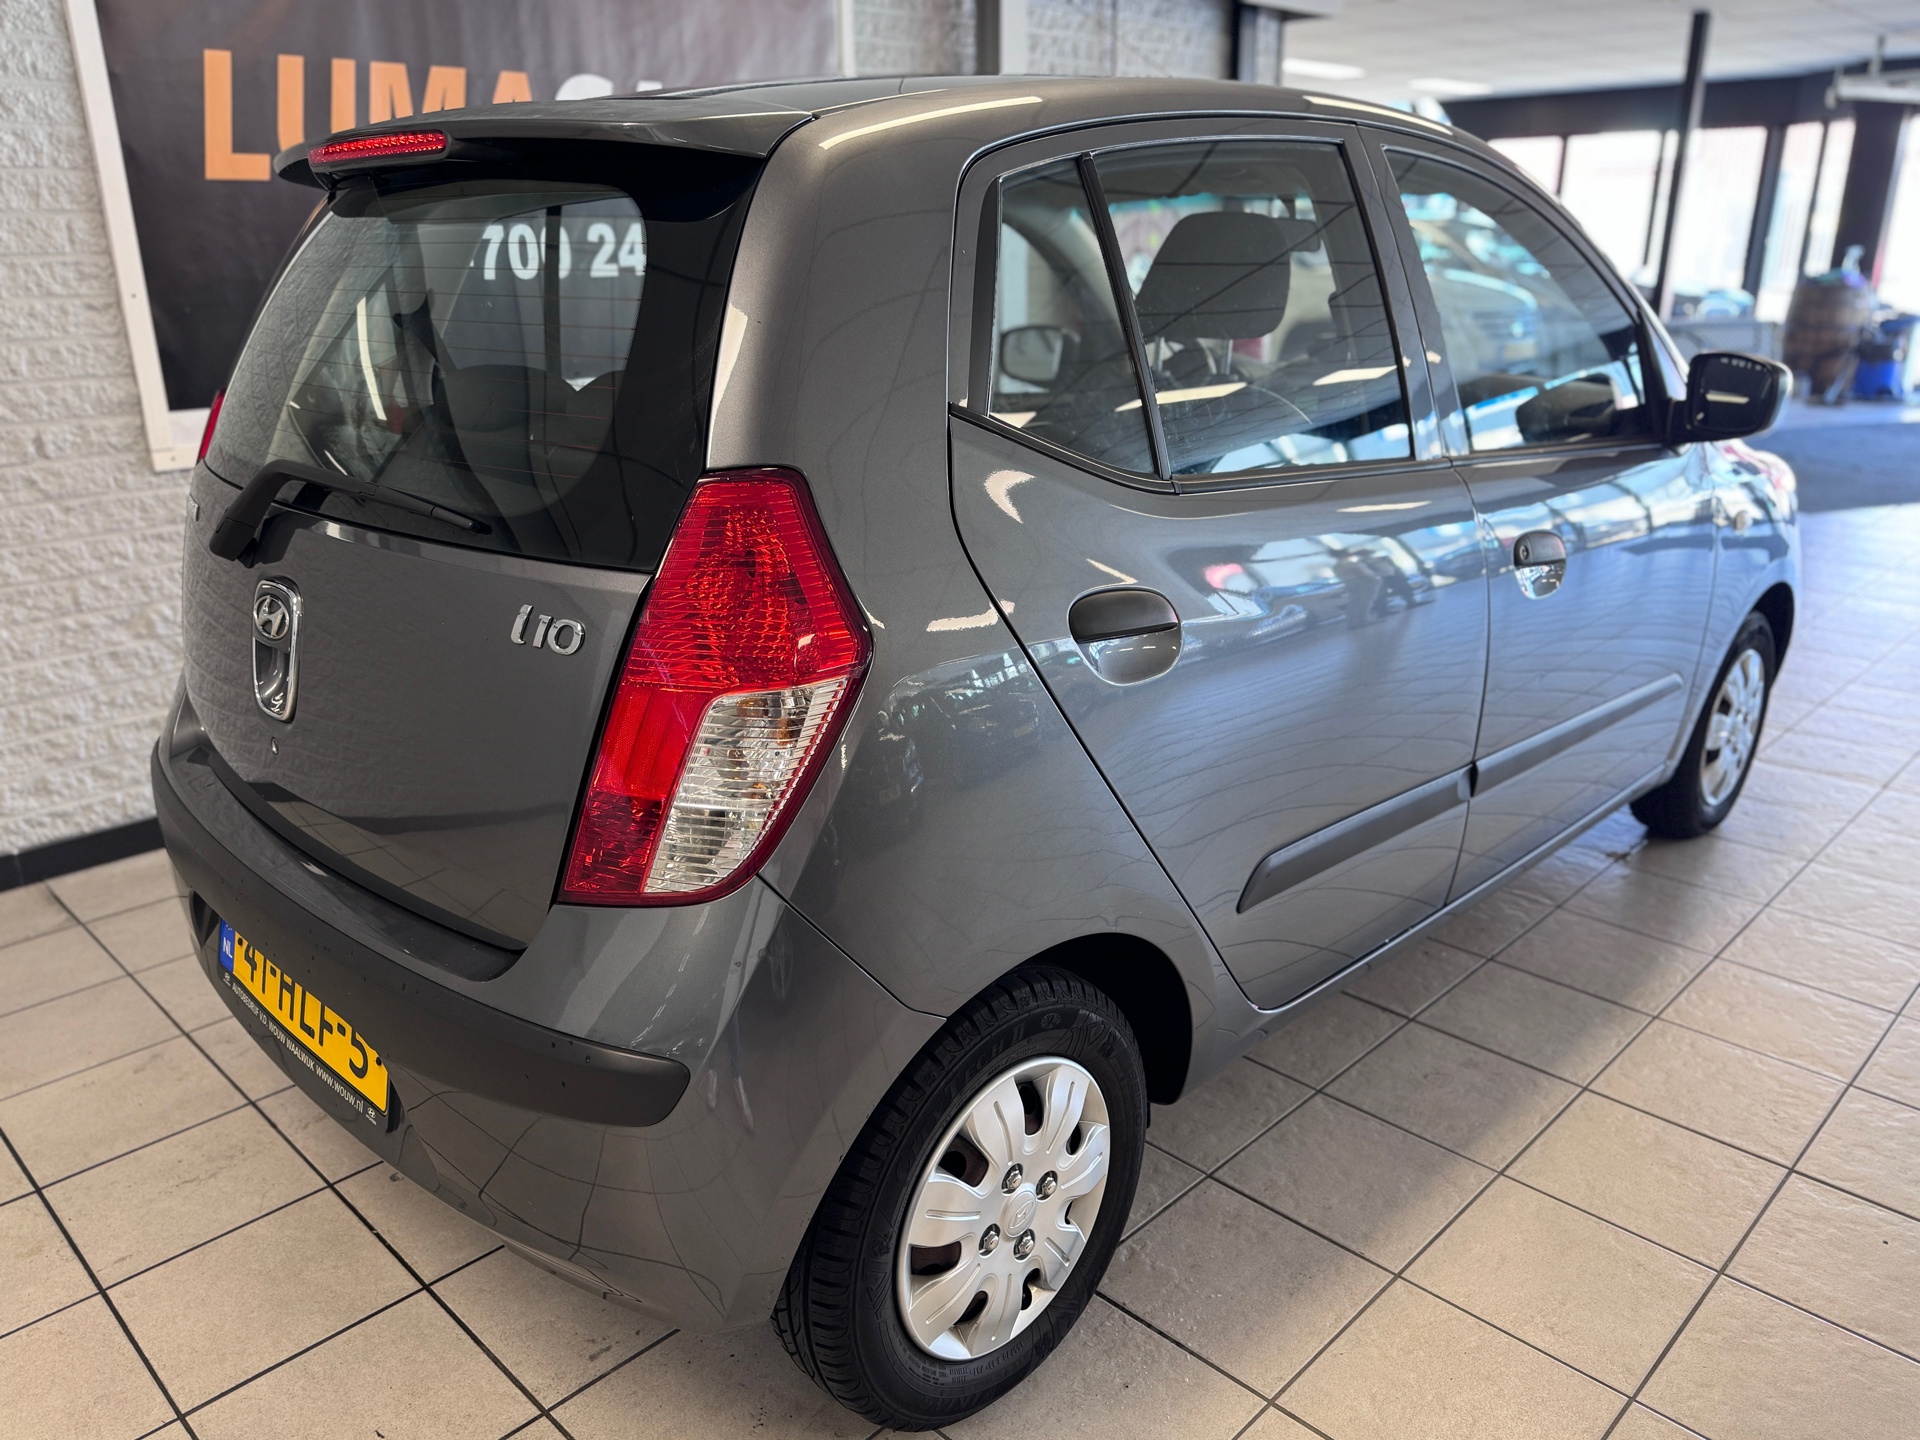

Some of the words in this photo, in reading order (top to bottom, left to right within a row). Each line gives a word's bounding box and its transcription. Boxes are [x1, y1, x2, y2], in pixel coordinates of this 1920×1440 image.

[223, 936, 233, 959] NL
[268, 1020, 286, 1044] WOUW
[286, 1037, 315, 1071] WAALWIJK
